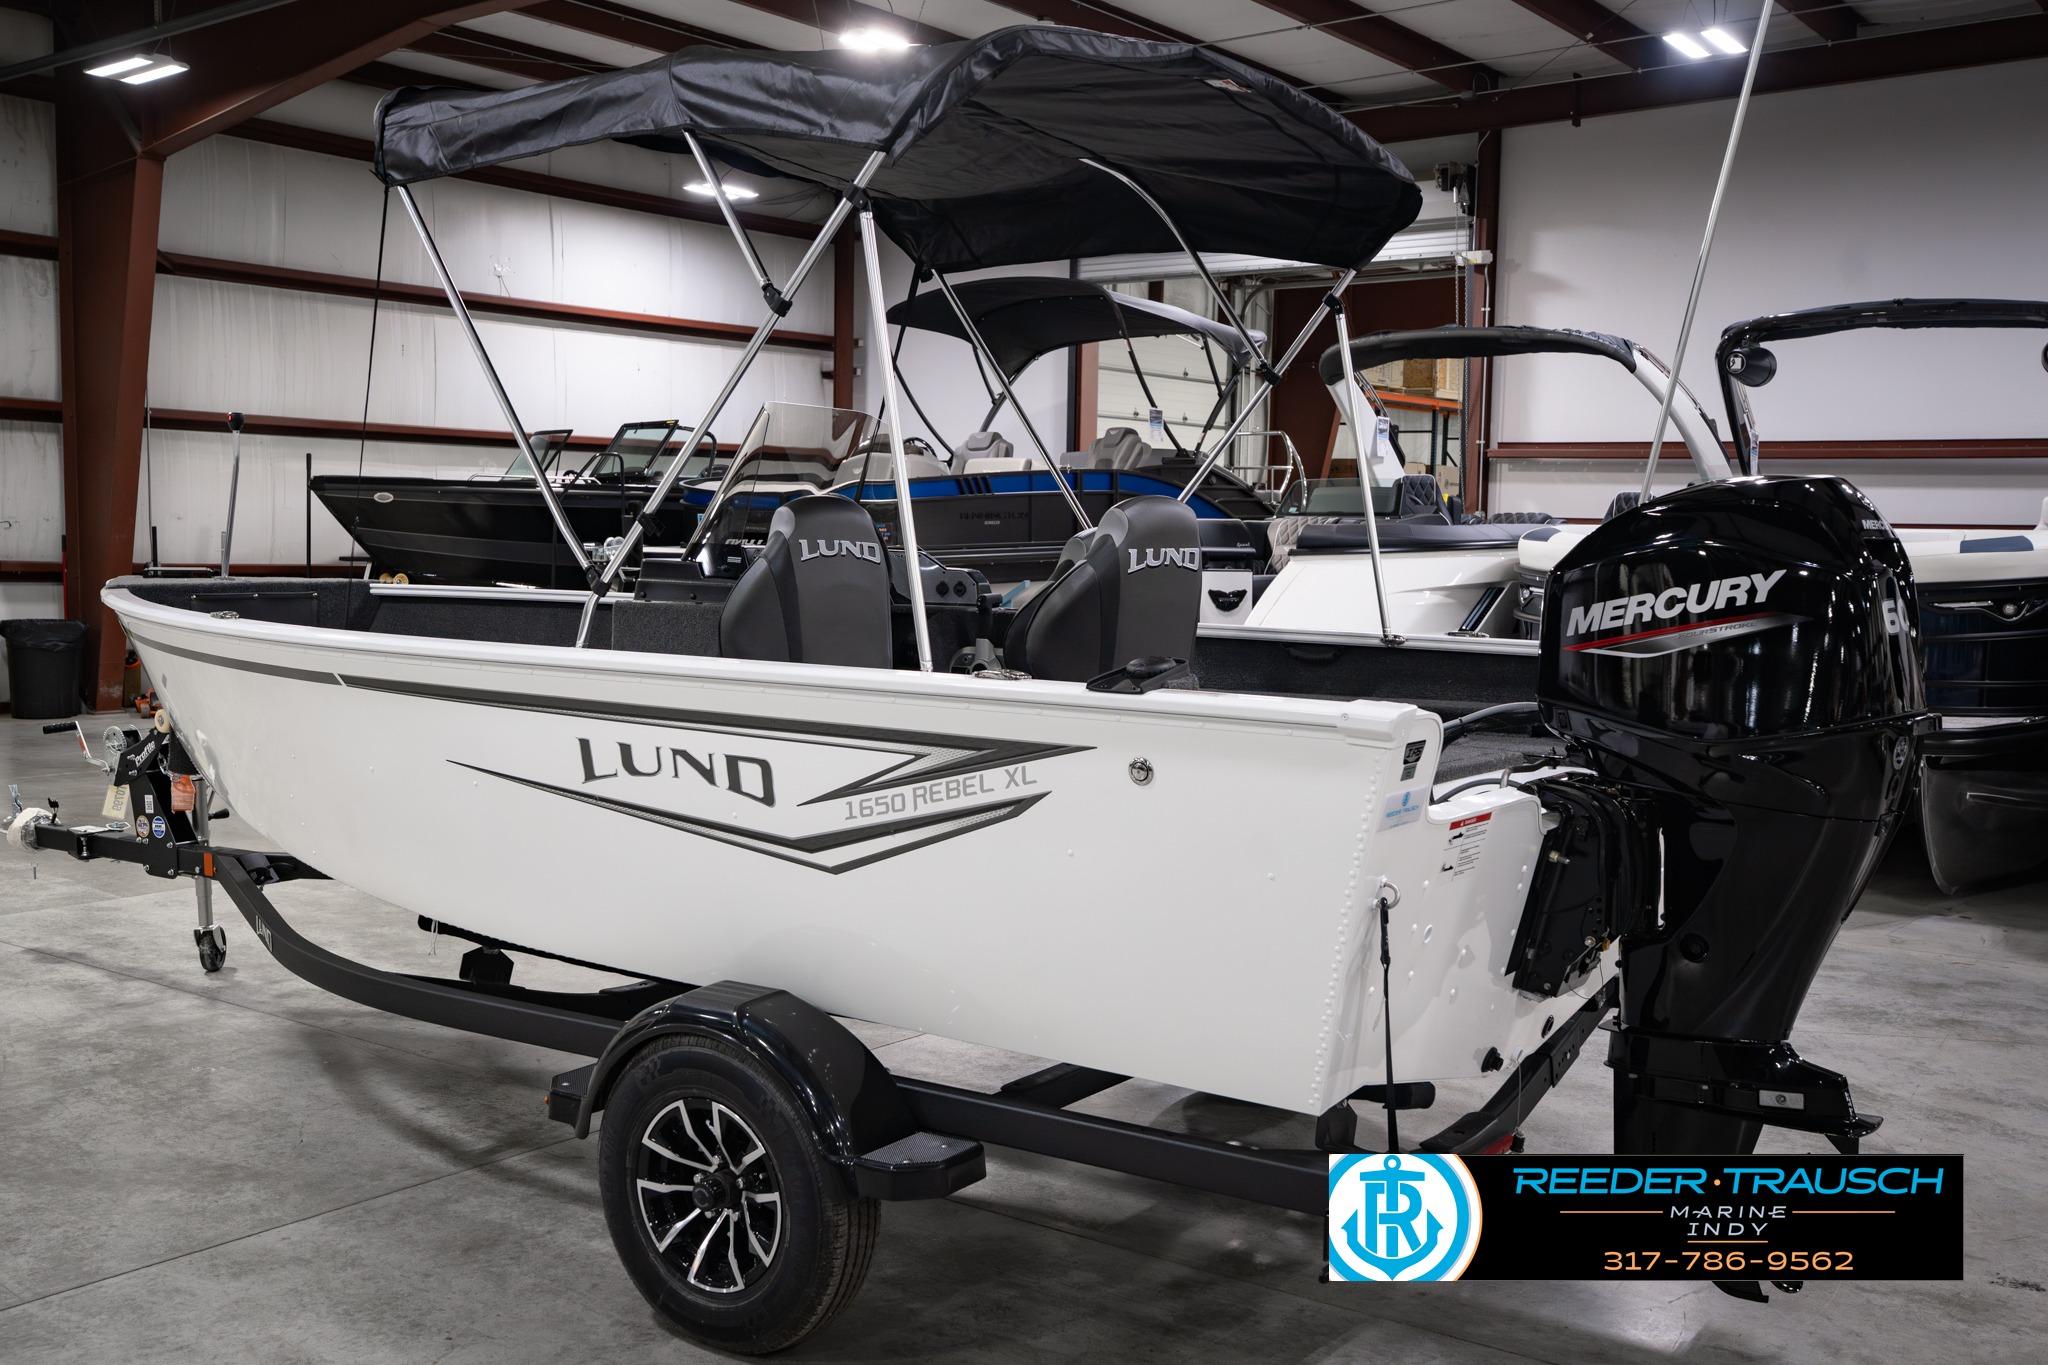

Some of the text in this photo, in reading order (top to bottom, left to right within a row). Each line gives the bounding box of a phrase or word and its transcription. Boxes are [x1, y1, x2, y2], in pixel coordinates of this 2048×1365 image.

[799, 539, 881, 563] LUND
[1127, 547, 1200, 574] LUND
[1566, 569, 1787, 637] MERCURY
[1882, 599, 1909, 634] 60
[576, 737, 777, 808] LUND
[845, 765, 1038, 820] 1650 REBEL XL
